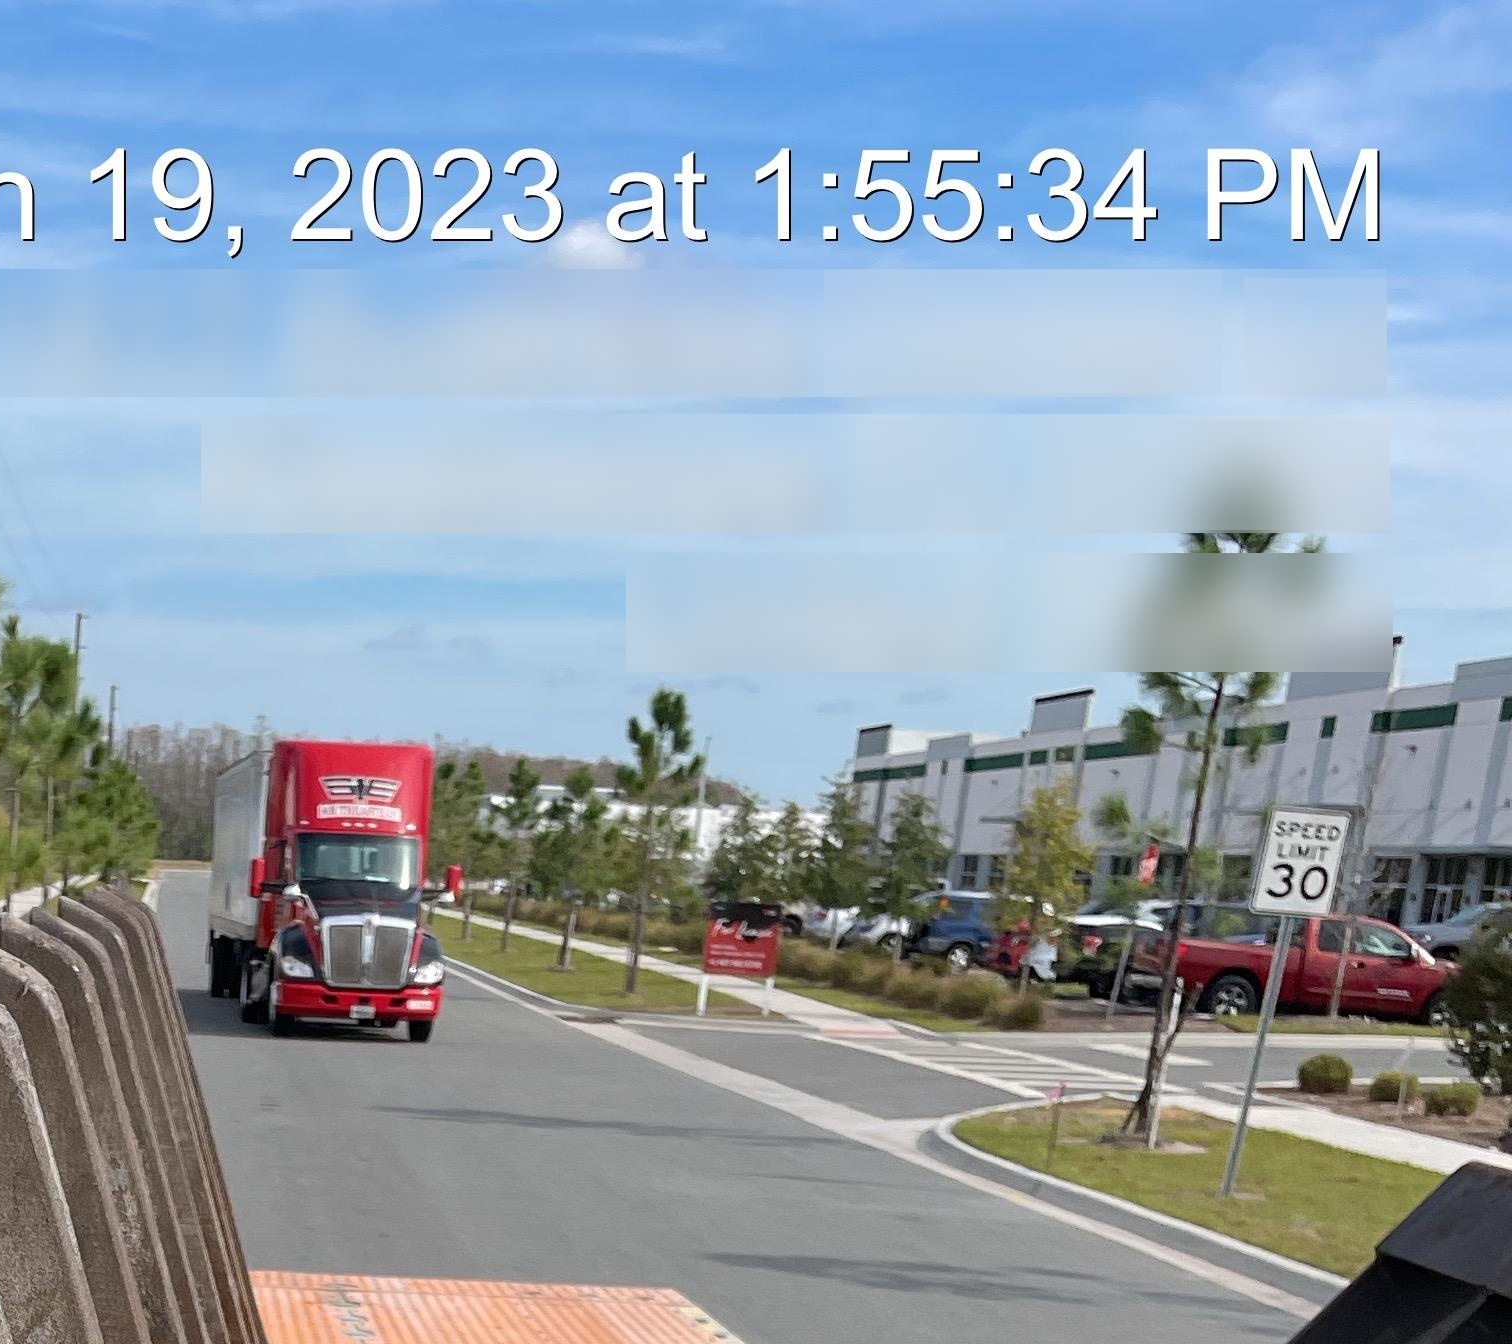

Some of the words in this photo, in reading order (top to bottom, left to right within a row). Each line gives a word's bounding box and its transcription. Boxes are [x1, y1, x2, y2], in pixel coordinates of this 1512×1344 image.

[1273, 820, 1341, 842] SPEED
[1275, 842, 1329, 862] LIMIT
[1265, 863, 1329, 901] 30
